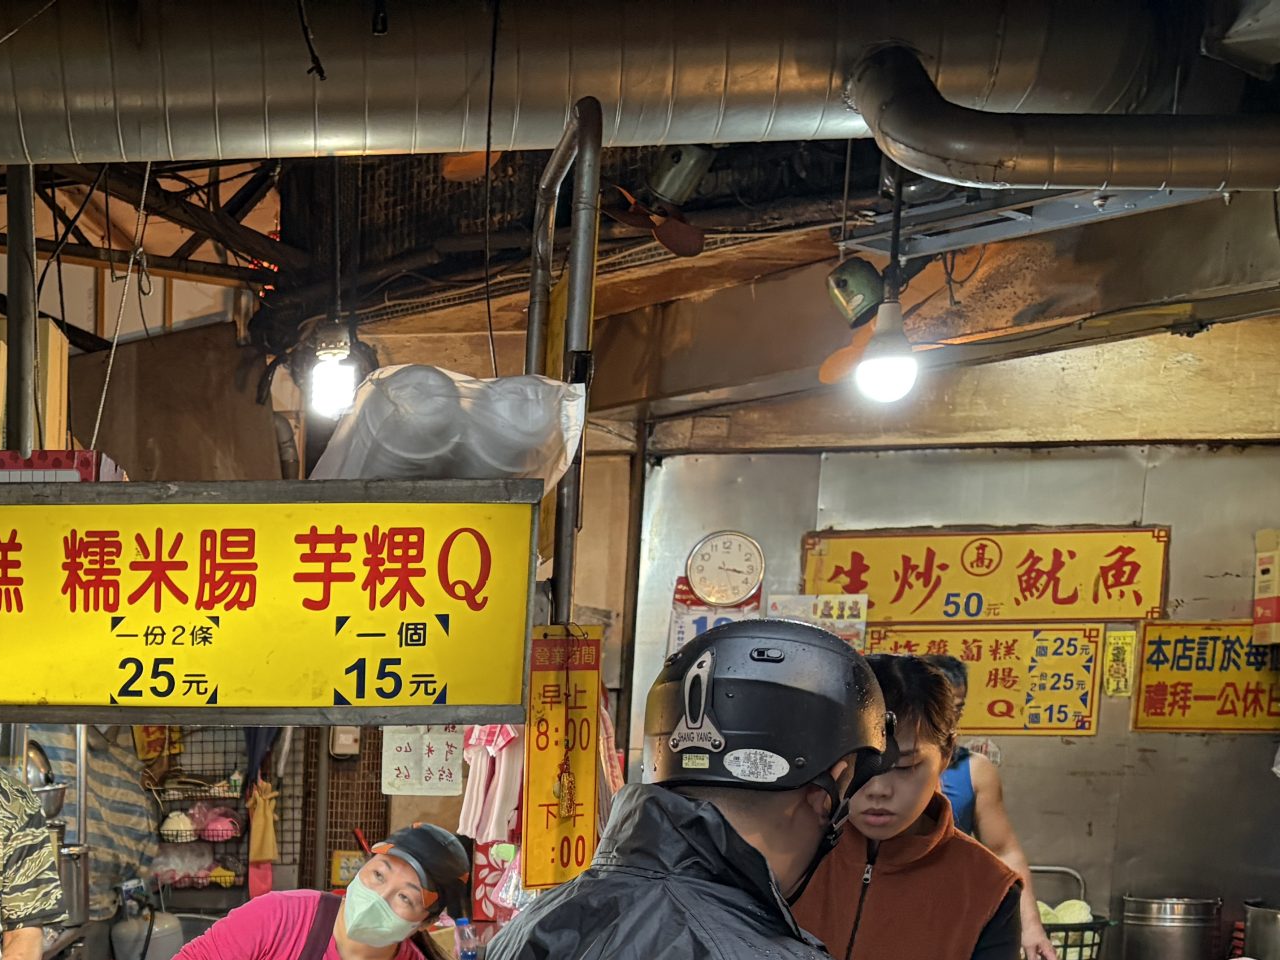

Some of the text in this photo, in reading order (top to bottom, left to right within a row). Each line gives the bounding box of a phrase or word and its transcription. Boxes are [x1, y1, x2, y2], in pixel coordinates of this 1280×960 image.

[722, 540, 733, 550] 12
[700, 552, 711, 562] 10
[744, 552, 753, 562] 2
[61, 527, 258, 613] 糯米腸
[293, 524, 492, 611] 芋粿Q
[746, 564, 754, 573] 3
[115, 625, 212, 647] 一份2條
[356, 621, 427, 648] 一個
[535, 646, 596, 665] 營業時間
[118, 657, 208, 698] 25元
[344, 657, 437, 699] 15元
[986, 667, 1019, 689] 腸
[541, 683, 587, 711] 早上
[987, 699, 1015, 718] Q
[677, 731, 712, 743] SHANG YANG
